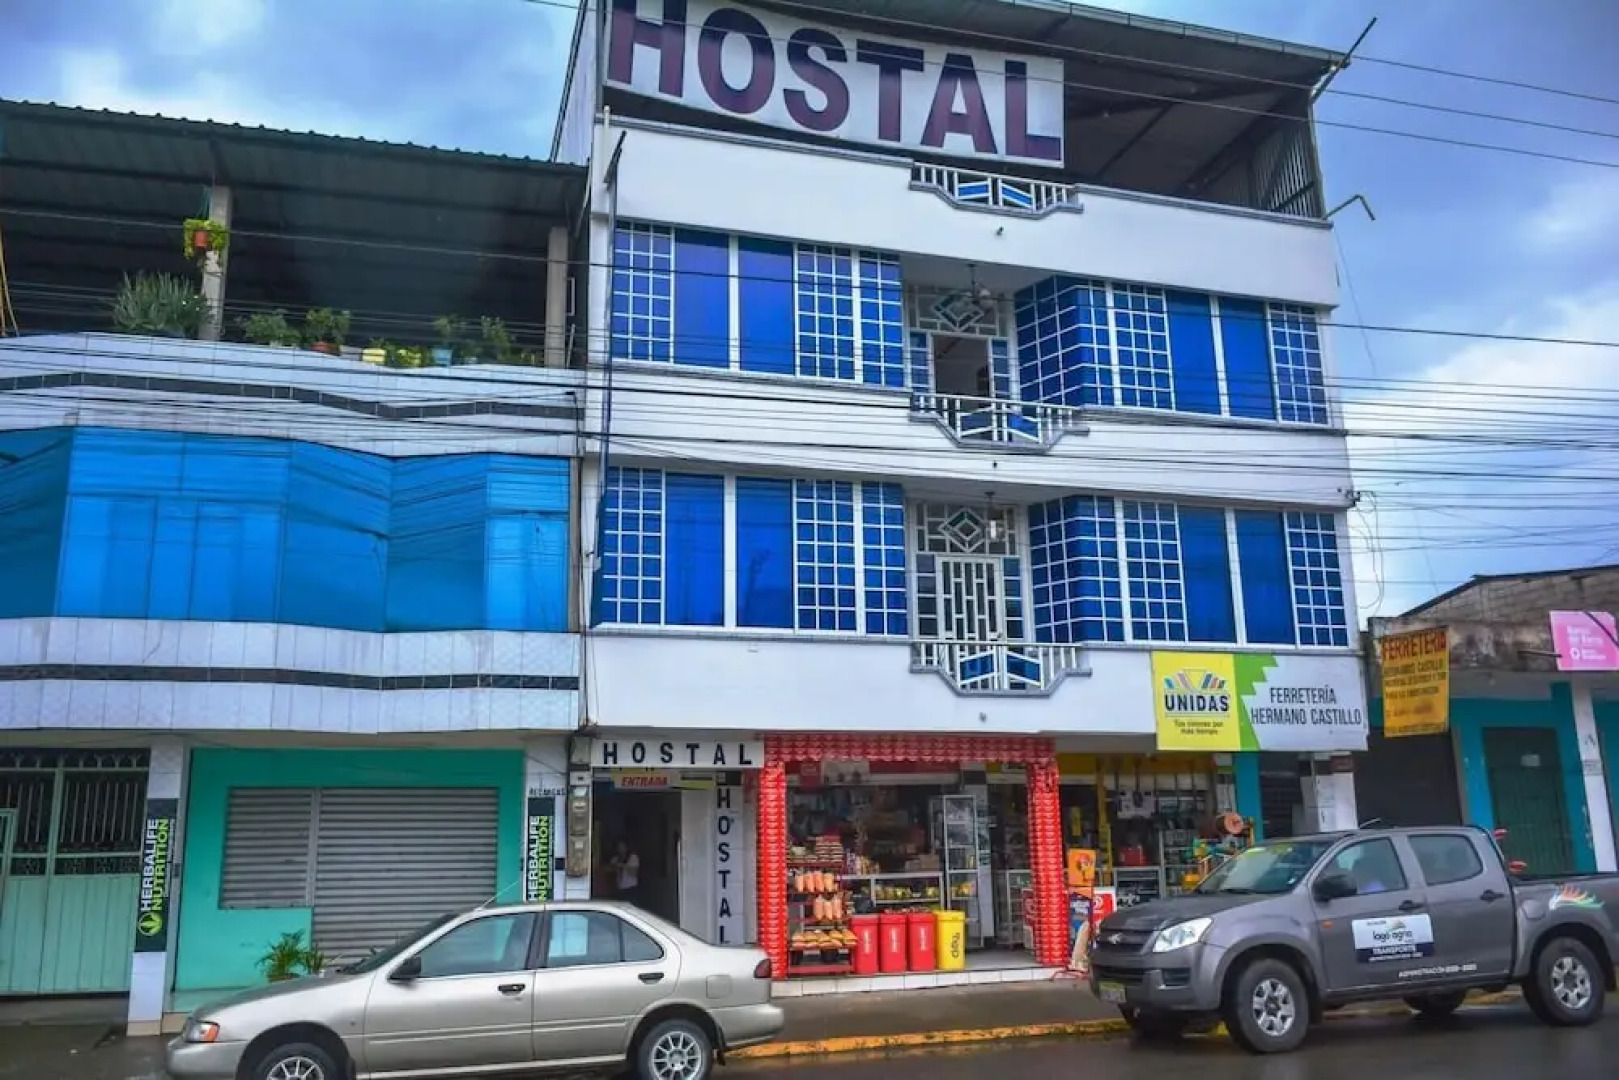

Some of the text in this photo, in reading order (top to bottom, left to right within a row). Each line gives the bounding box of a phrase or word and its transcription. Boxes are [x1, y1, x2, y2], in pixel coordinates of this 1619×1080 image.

[608, 0, 1061, 161] HOSTAL
[1165, 694, 1229, 712] UNIDAS
[1251, 707, 1362, 725] HERMANO CASTILLO
[1270, 684, 1337, 704] FERRETERÍA
[603, 742, 752, 765] HOSTAL
[621, 776, 668, 787] ENTRADA
[140, 818, 158, 911] HERBALIFE
[152, 818, 169, 911] NUTRITION
[527, 815, 540, 902] HERBALIFE
[537, 815, 550, 902] NUTRITION
[716, 788, 732, 945] HOSTAL
